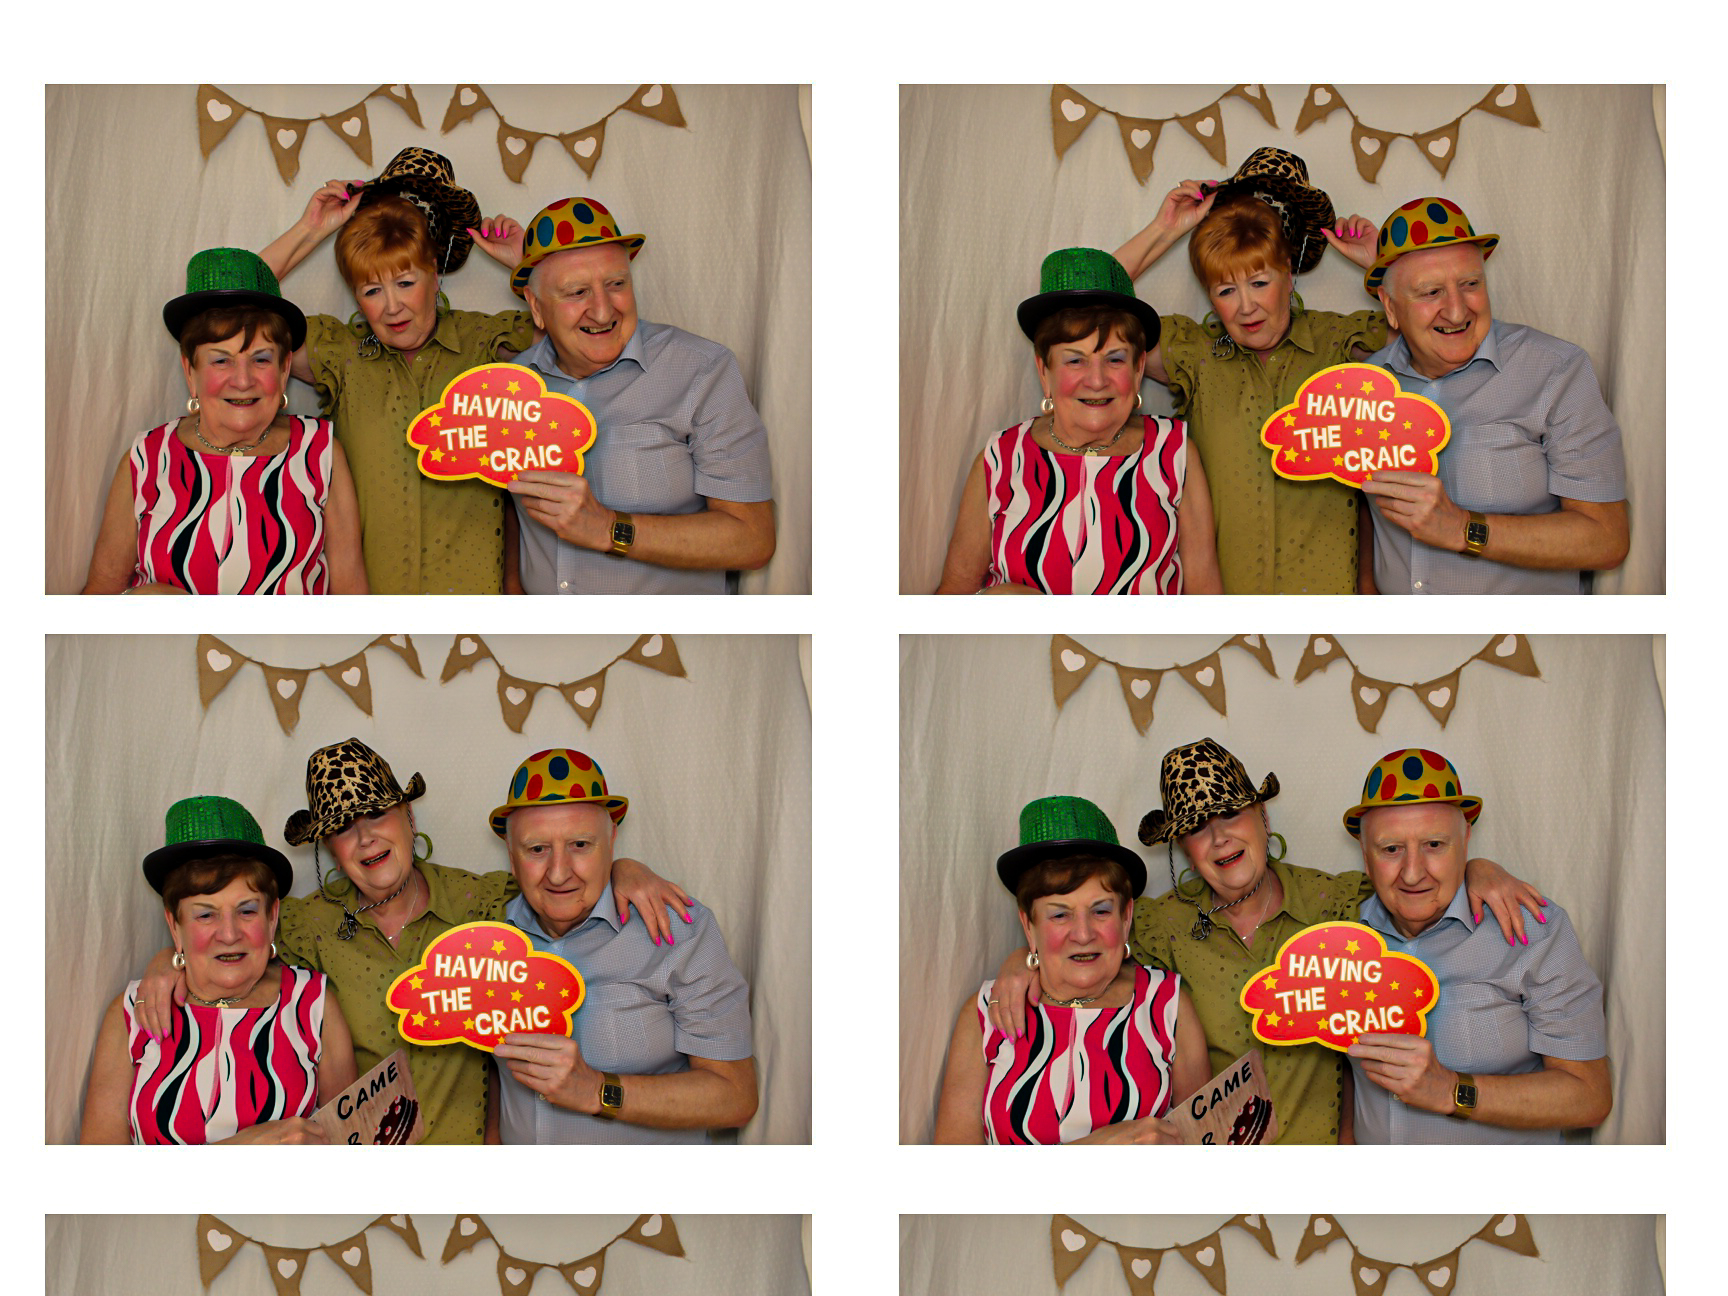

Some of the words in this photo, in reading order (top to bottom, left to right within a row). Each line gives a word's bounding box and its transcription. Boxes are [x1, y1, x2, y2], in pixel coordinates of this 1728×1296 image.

[453, 393, 542, 422] HAVING
[1307, 393, 1396, 422] HAVING
[439, 425, 488, 451] THE
[1293, 425, 1342, 451] THE
[489, 444, 563, 472] CRAIC
[1343, 444, 1417, 472] CRAIC
[434, 953, 528, 984] HAVING
[1288, 953, 1382, 984] HAVING
[420, 986, 473, 1015] THE
[1274, 986, 1327, 1015] THE
[474, 1005, 551, 1035] CRAIC
[1328, 1005, 1405, 1035] CRAIC
[337, 1061, 399, 1120] CAME
[1191, 1061, 1253, 1120] CAME
